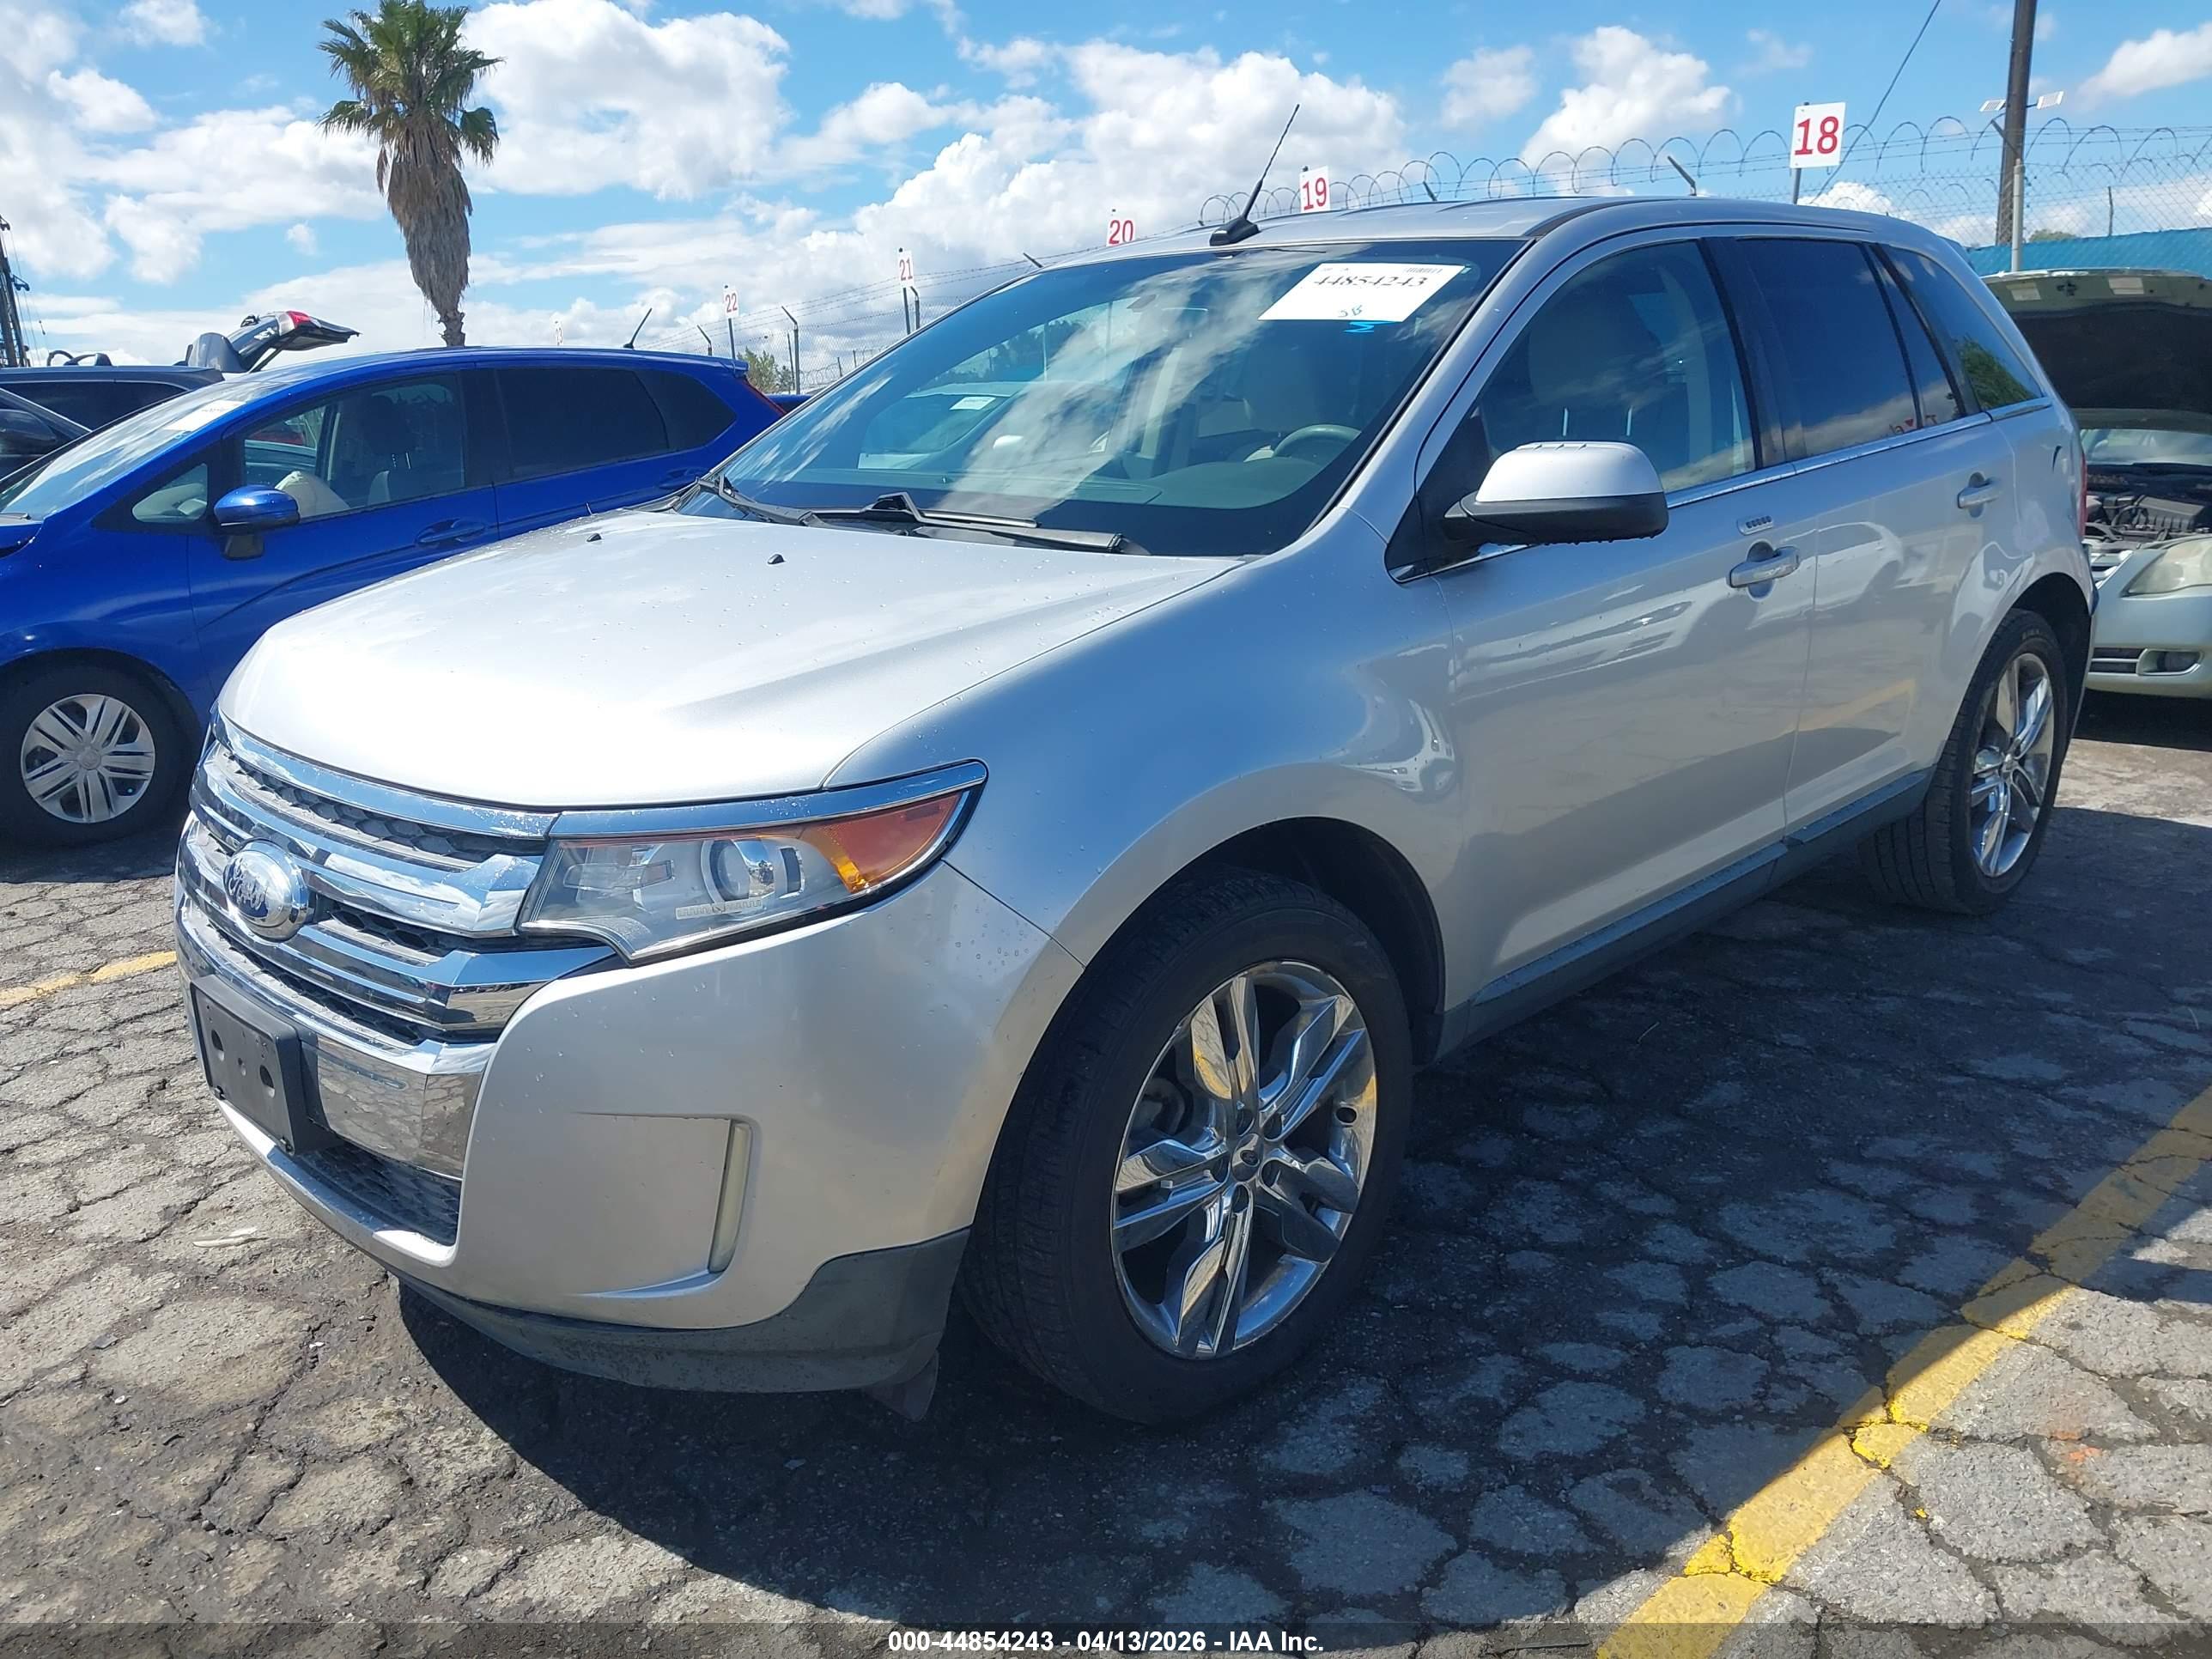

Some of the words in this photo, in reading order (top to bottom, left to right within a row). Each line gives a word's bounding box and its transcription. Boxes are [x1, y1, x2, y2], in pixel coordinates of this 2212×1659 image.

[1795, 116, 1839, 155] 18
[1302, 177, 1327, 210] 19
[1109, 219, 1133, 245] 20
[899, 258, 913, 281] 21
[1313, 276, 1428, 287] 44854243
[725, 292, 738, 313] 22
